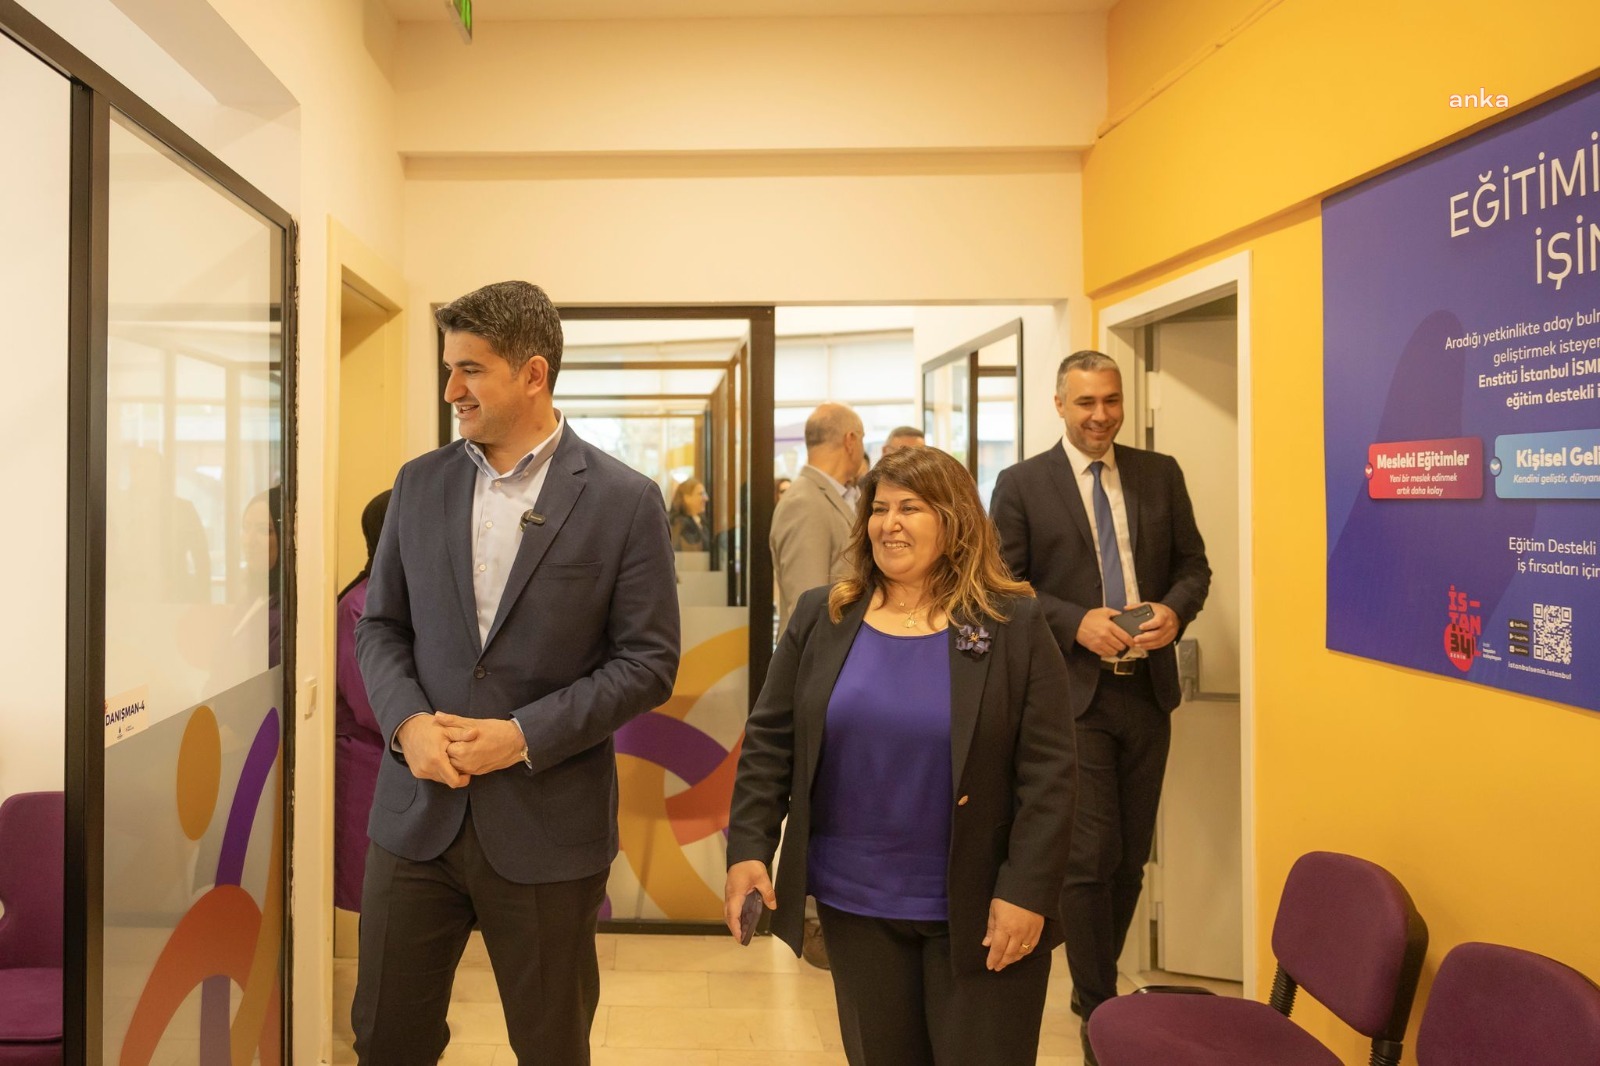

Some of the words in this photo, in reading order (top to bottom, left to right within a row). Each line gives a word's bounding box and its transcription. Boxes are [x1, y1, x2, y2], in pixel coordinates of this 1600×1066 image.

[1450, 131, 1600, 238] EĞİTİMİ
[1445, 332, 1481, 350] Aradığı
[1483, 322, 1541, 346] yetkinlikte
[1543, 315, 1574, 332] aday
[1493, 340, 1557, 367] geliştirmek
[1478, 369, 1518, 388] Enstitü
[1520, 362, 1569, 383] İstanbul
[1506, 390, 1543, 410] eğitim
[1545, 384, 1595, 404] destekli
[1377, 453, 1416, 470] Mesleki
[1417, 450, 1470, 471] Eğitimler
[1516, 447, 1567, 471] Kişisel
[1389, 474, 1401, 483] Yeni
[1402, 473, 1410, 483] bir
[1410, 473, 1431, 483] meslek
[1431, 472, 1458, 482] edinmek
[1513, 473, 1540, 484] Kendini
[1411, 486, 1426, 495] daha
[1427, 485, 1444, 497] kolay
[1508, 537, 1545, 554] Eğitim
[1548, 538, 1597, 556] Destekli
[1517, 558, 1526, 574] iş
[1528, 558, 1579, 576] fırsatları
[105, 700, 145, 727] DANIŞMAN-4
